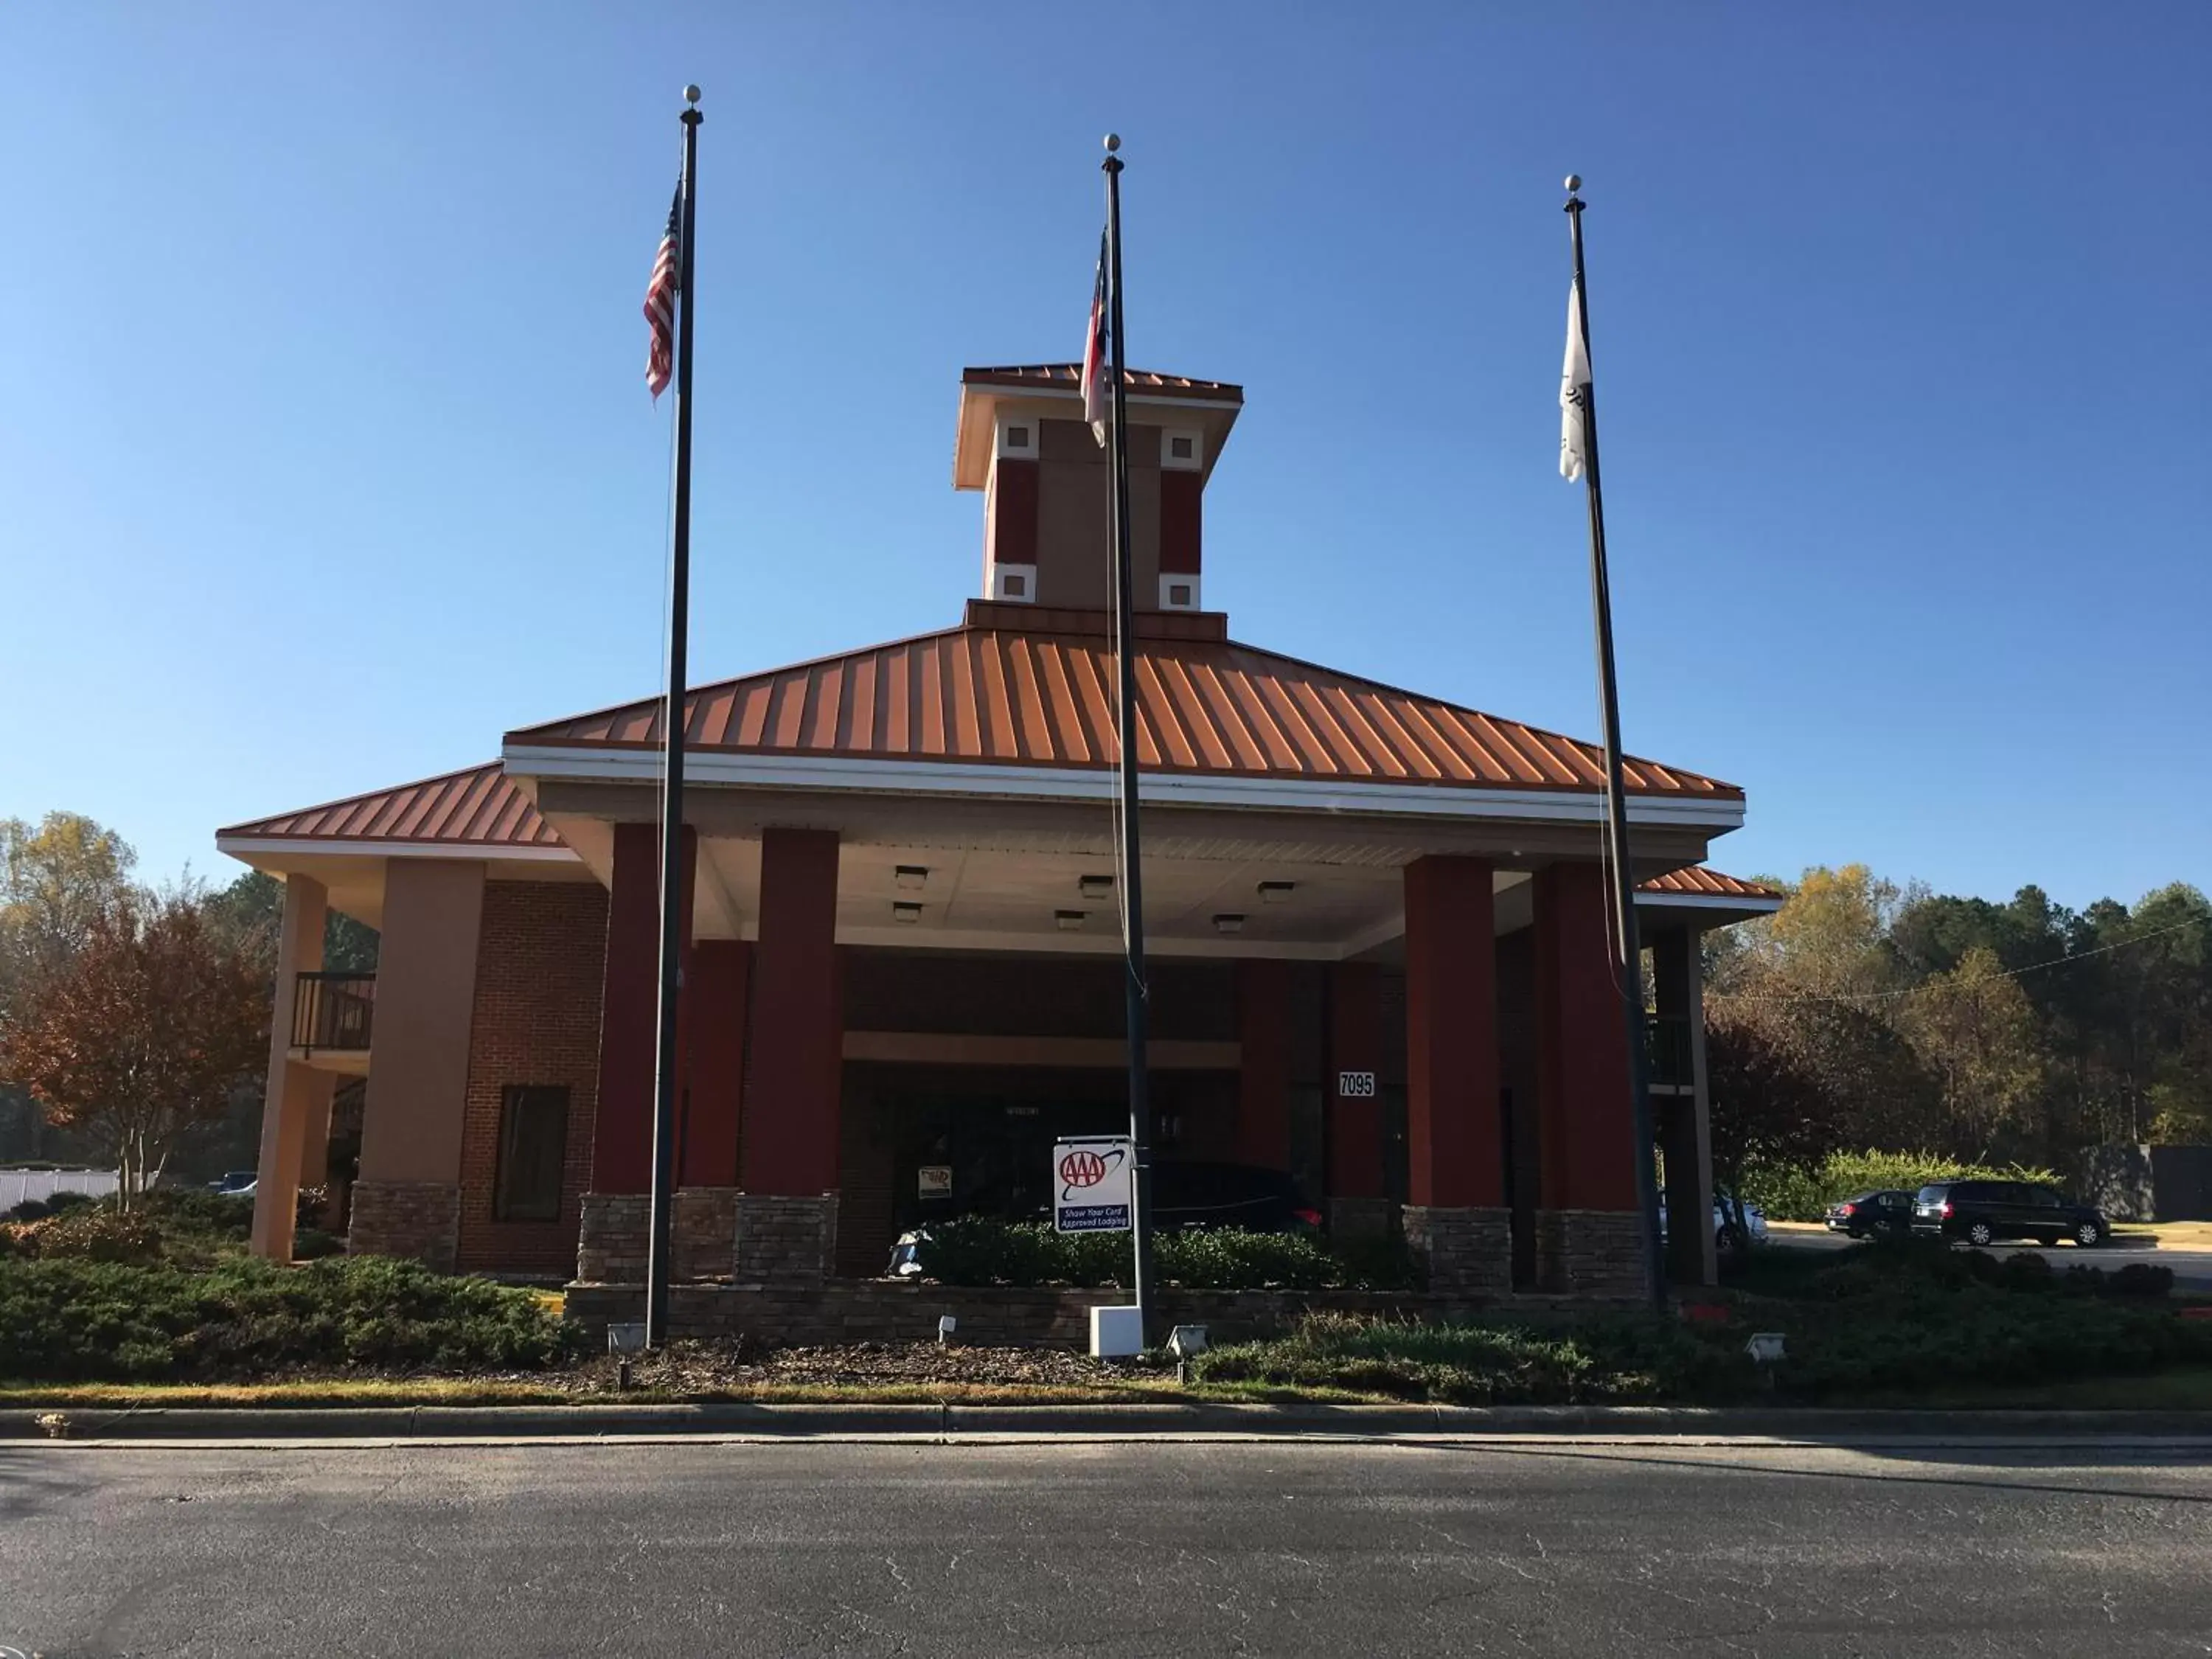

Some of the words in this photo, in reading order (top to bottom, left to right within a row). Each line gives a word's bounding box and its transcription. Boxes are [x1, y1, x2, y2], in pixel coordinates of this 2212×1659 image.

[1341, 1074, 1372, 1094] 7095
[1065, 1152, 1100, 1185] AAA
[1065, 1208, 1086, 1218] Show
[1088, 1208, 1104, 1217] Your
[1105, 1207, 1122, 1216] Card
[1061, 1218, 1096, 1229] Approved
[1098, 1217, 1127, 1228] Lodging
